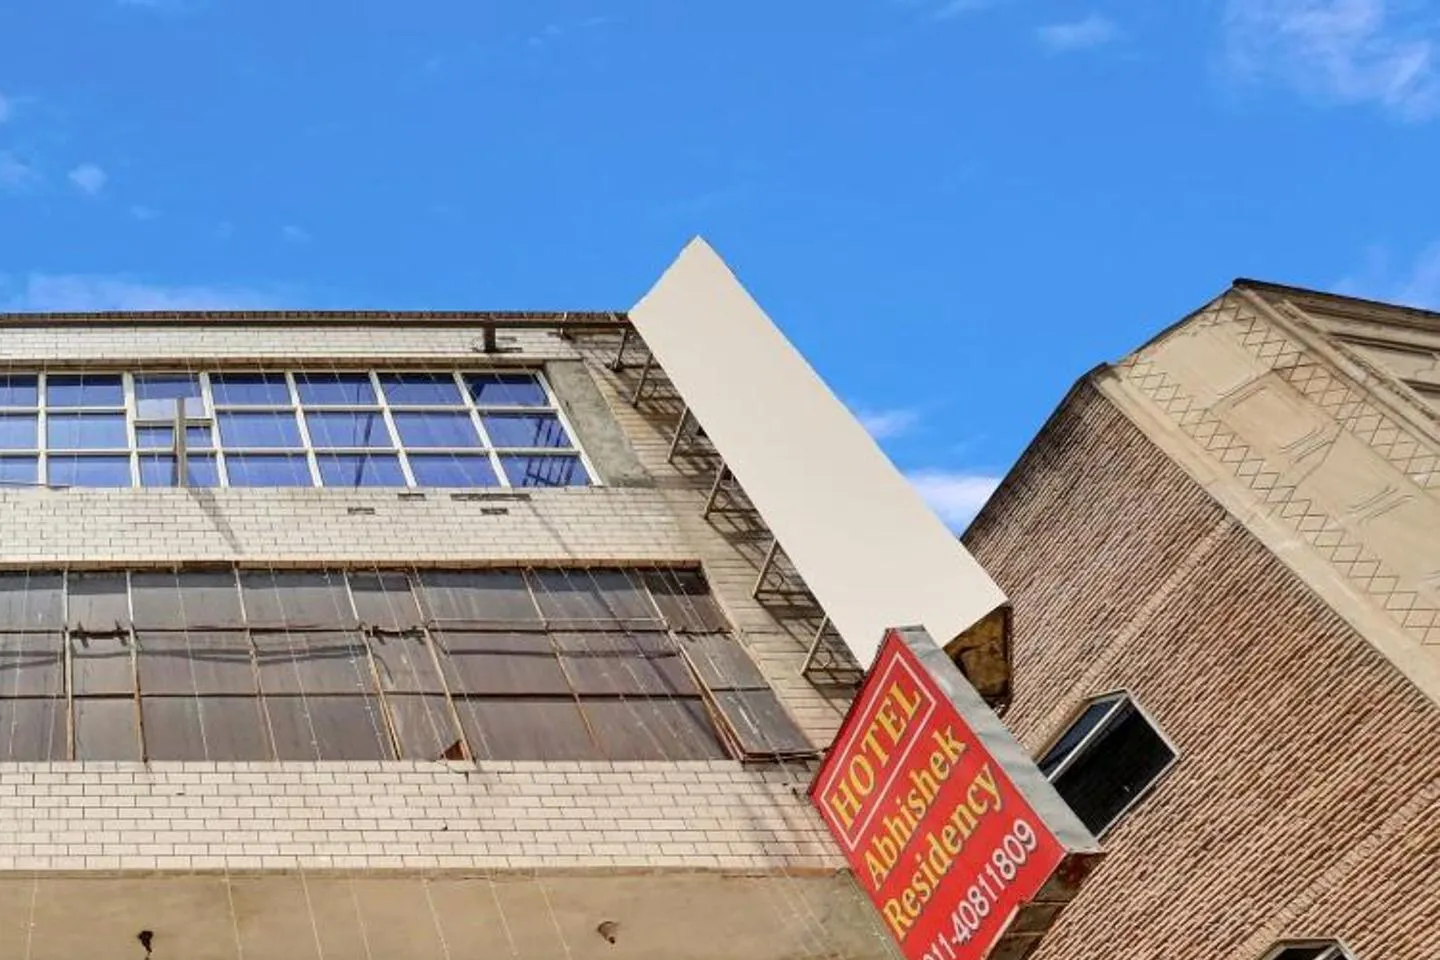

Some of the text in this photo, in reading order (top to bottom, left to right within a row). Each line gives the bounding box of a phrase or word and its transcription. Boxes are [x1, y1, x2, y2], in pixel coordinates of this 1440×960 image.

[831, 682, 922, 830] HOTEL
[862, 725, 968, 891] Abhishek
[883, 763, 1002, 941] Residency
